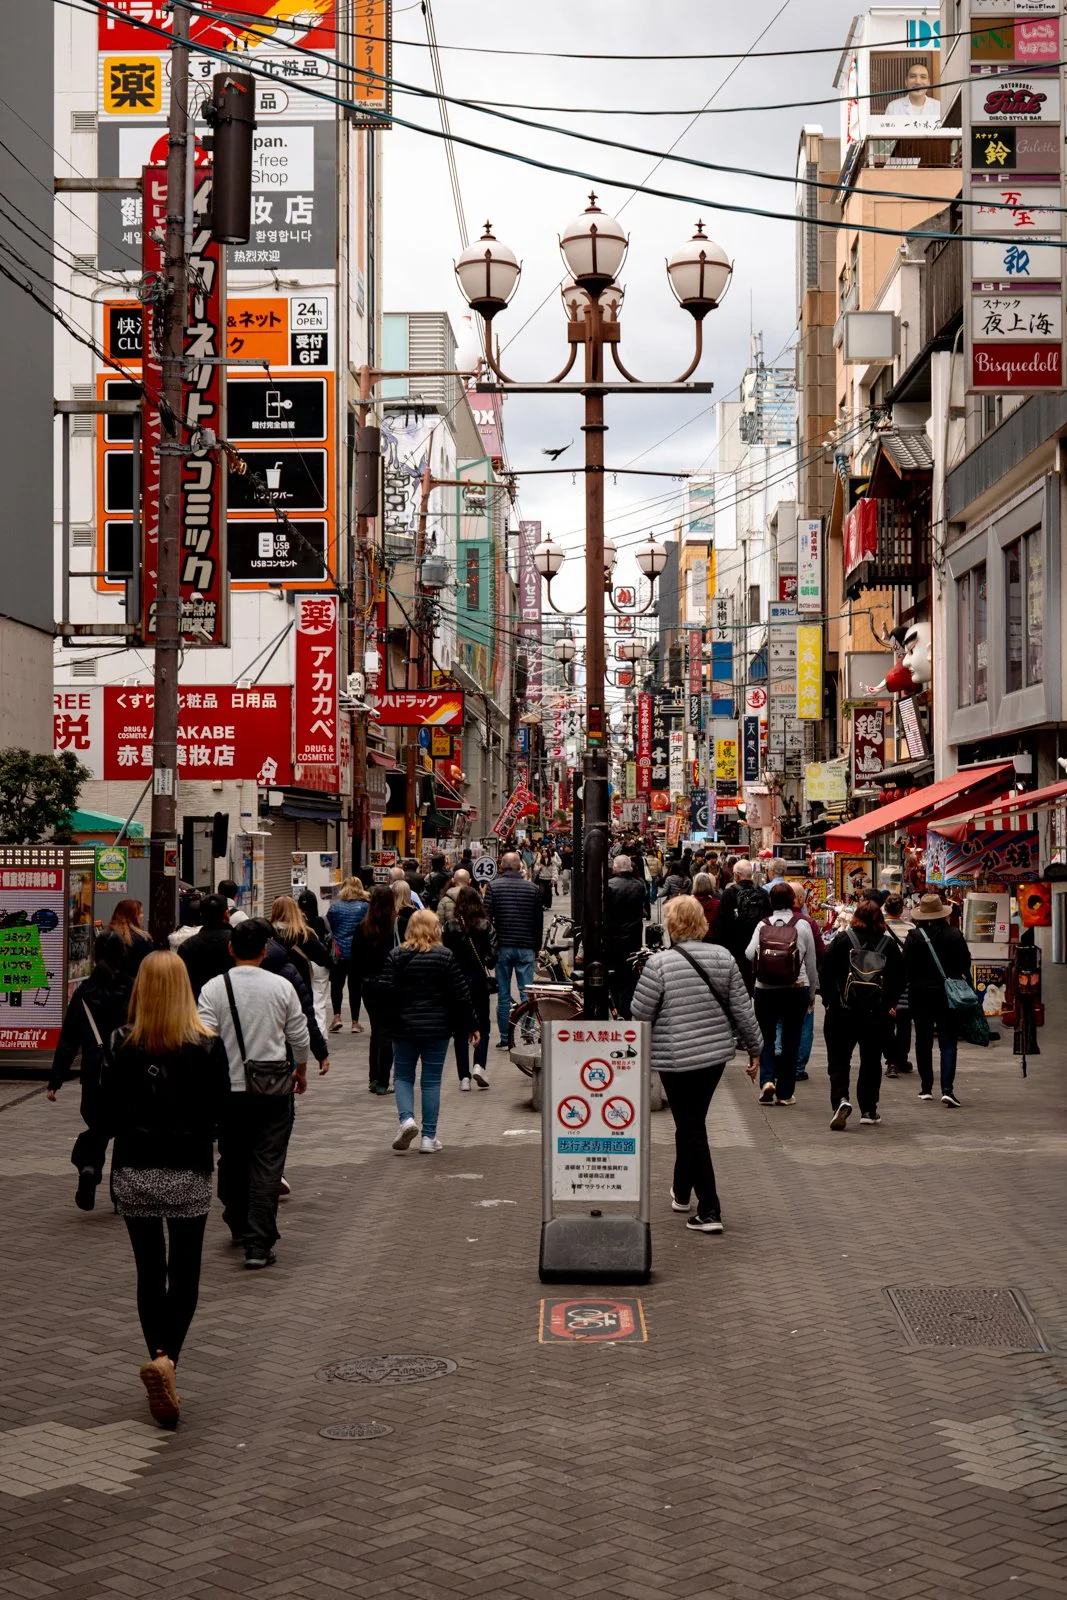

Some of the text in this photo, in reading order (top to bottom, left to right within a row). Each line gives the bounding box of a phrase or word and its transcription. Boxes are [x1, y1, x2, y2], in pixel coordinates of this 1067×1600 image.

[110, 63, 155, 107] 薬
[985, 140, 1011, 165] 鈴
[255, 230, 312, 243] 환영합니다
[234, 250, 280, 263] 热烈欢迎
[297, 303, 323, 318] 24h
[982, 299, 1021, 310] スナック
[296, 318, 323, 326] OPEN
[981, 311, 1054, 336] 夜上海
[296, 335, 323, 350] 受付
[299, 351, 320, 364] 6F
[975, 352, 1060, 382] Bisquedoll
[276, 550, 288, 558] OK
[250, 559, 298, 568] USBコンセント
[301, 600, 333, 632] 薬
[310, 645, 334, 739] アカカベ
[231, 693, 277, 709] 日用品
[298, 753, 334, 761] COSMETIC
[476, 862, 494, 876] 43
[573, 1030, 622, 1043] 進入禁止
[559, 1140, 634, 1152] 歩行者専用道路
